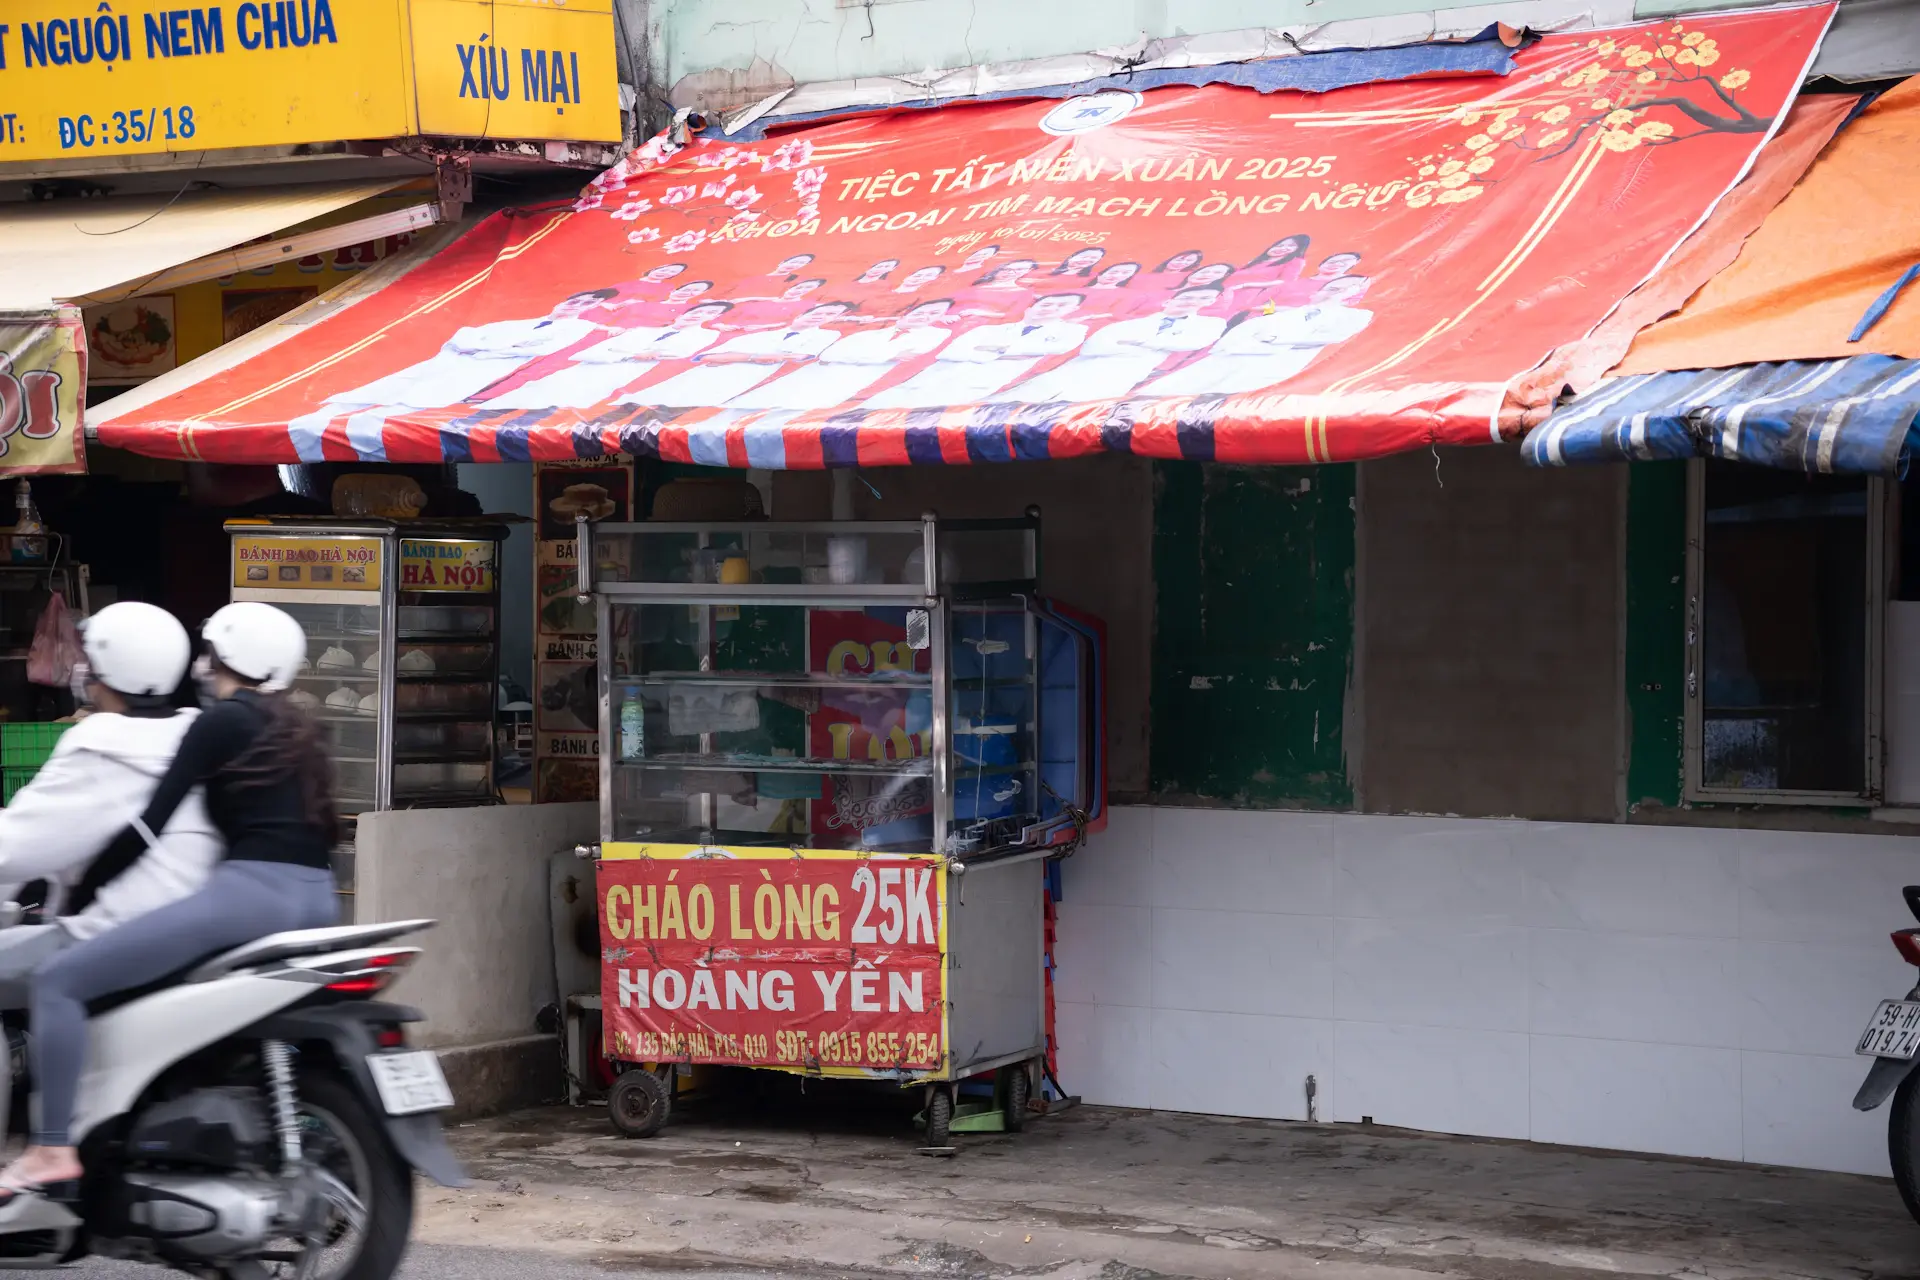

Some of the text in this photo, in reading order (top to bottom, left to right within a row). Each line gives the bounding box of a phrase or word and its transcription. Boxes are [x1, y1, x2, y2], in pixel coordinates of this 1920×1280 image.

[21, 2, 131, 72] NGUỘI
[143, 7, 224, 59] NEM
[236, 0, 338, 50] CHUA
[455, 32, 580, 115] XÍU MẠI
[837, 150, 1338, 201] TIỆC TẤT NIÊN XUÂN 2025
[713, 180, 1439, 240] KHOA NGOẠI TIM MẠCH LỒNG NGỰC
[935, 230, 987, 256] ngày
[239, 546, 376, 564] BÁNH BAO HÀ NỘI
[403, 543, 463, 559] BÁNH BAO
[402, 559, 485, 590] HÀ NỘI
[552, 736, 587, 754] BÁNH
[606, 866, 936, 944] CHÁO LÒNG 25K
[618, 956, 924, 1013] HOÀNG YẾN
[635, 1032, 658, 1055] 135
[661, 1022, 686, 1058] BẮC
[744, 1034, 768, 1062] Q10
[775, 1030, 813, 1062] SĐT:
[819, 1031, 862, 1063] 0915
[866, 1031, 900, 1064] 855
[906, 1032, 938, 1064] 254
